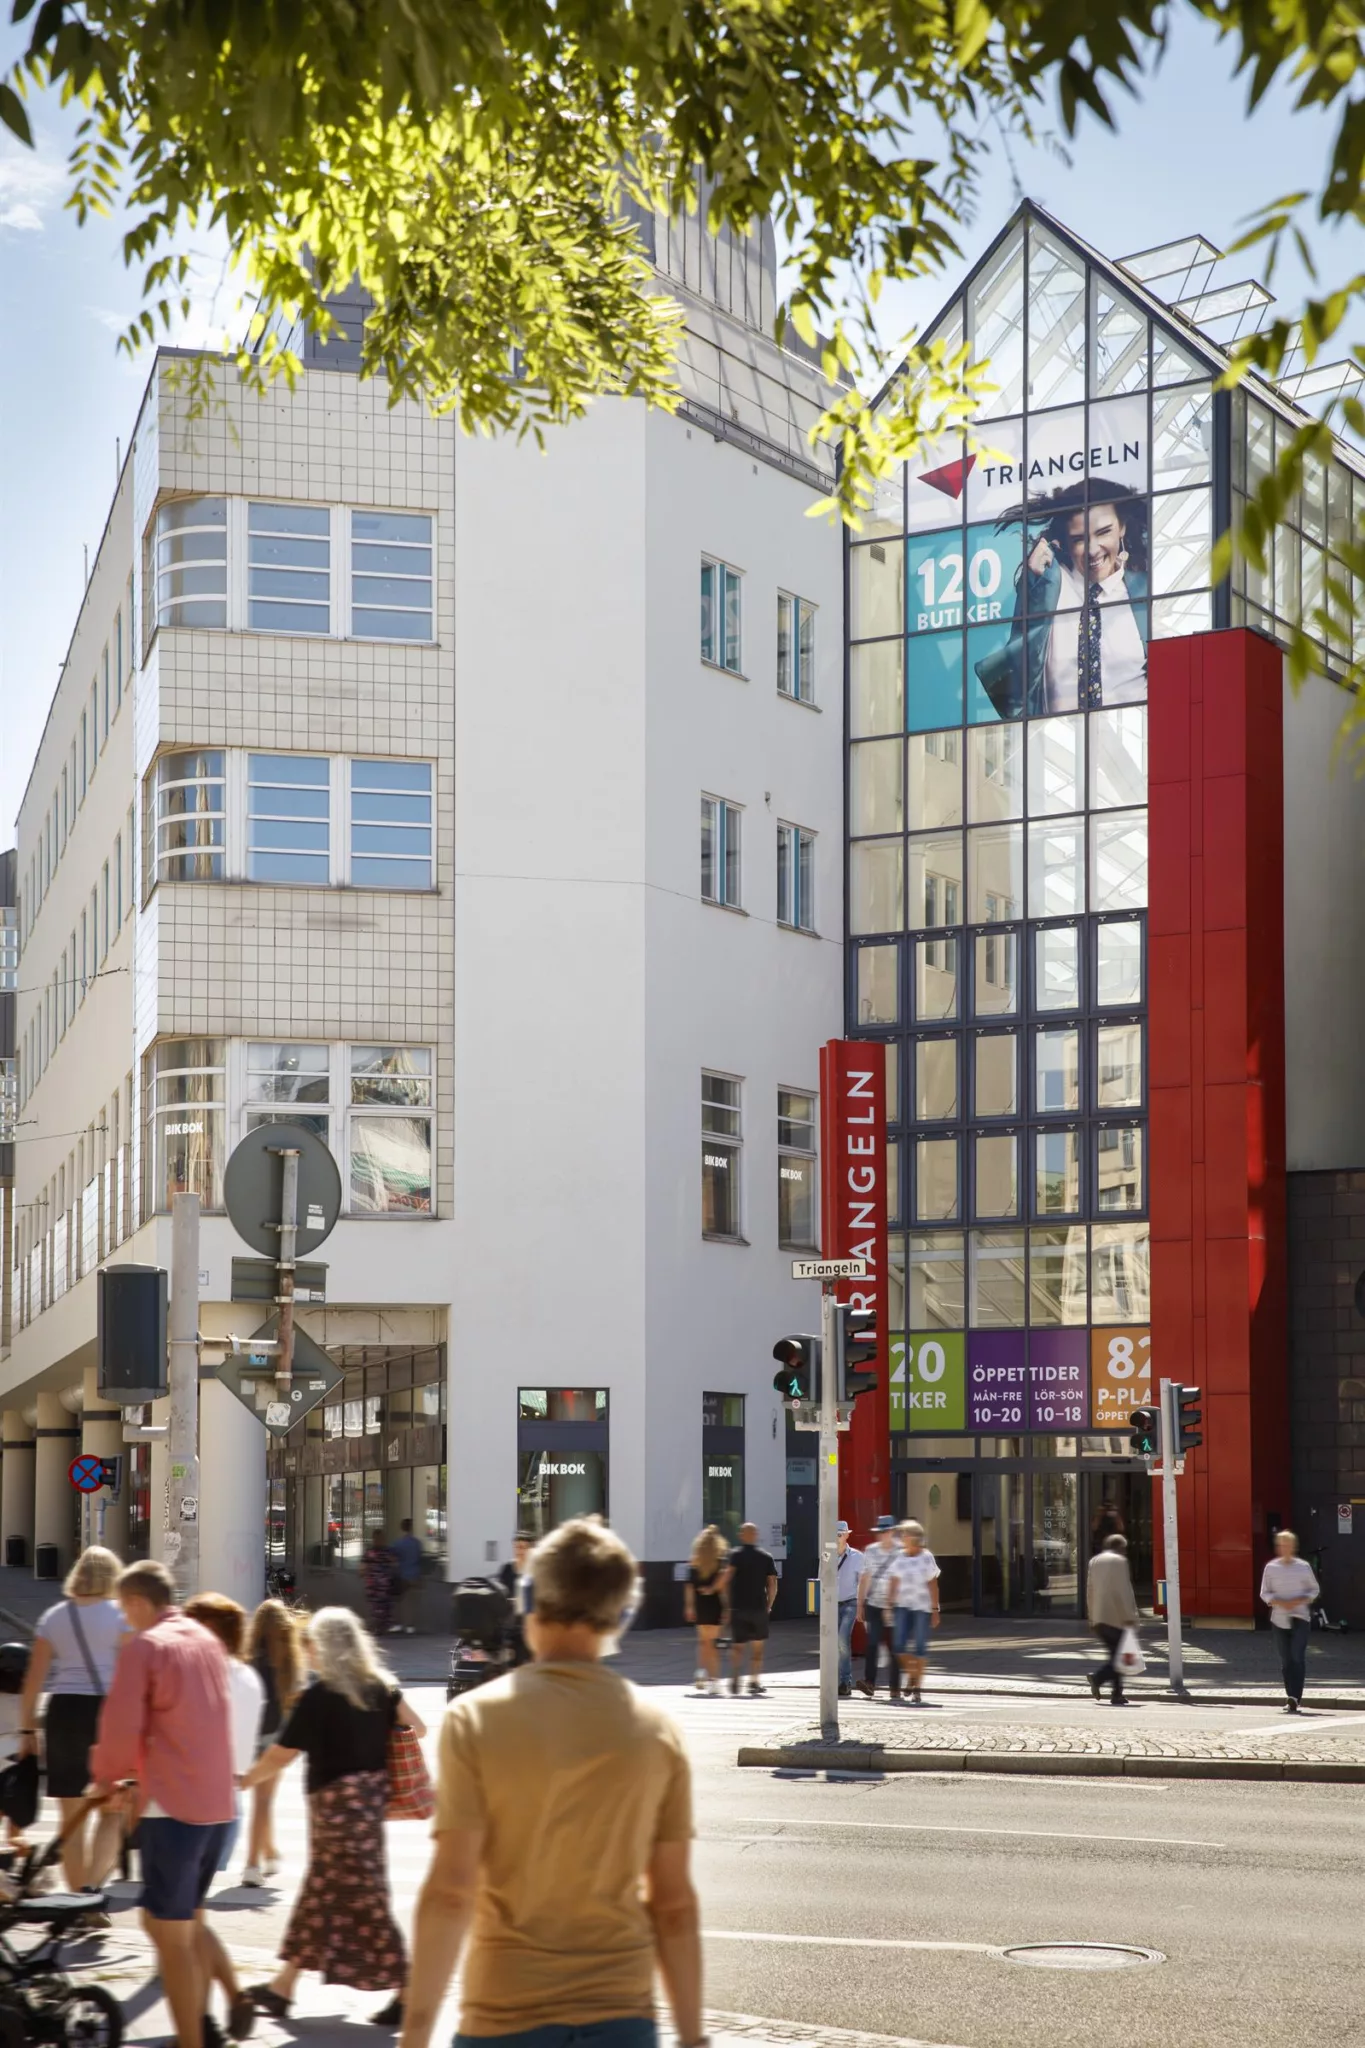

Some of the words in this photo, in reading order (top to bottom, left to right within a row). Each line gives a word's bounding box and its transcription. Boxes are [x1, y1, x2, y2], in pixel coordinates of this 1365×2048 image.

[983, 441, 1140, 487] TRIANGELN
[917, 548, 1002, 607] 120
[917, 602, 1002, 631] BUTIKER
[799, 1262, 860, 1276] Triangeln
[1096, 1409, 1129, 1420] ÖPPET
[539, 1463, 559, 1475] BIK
[560, 1463, 585, 1475] BOK
